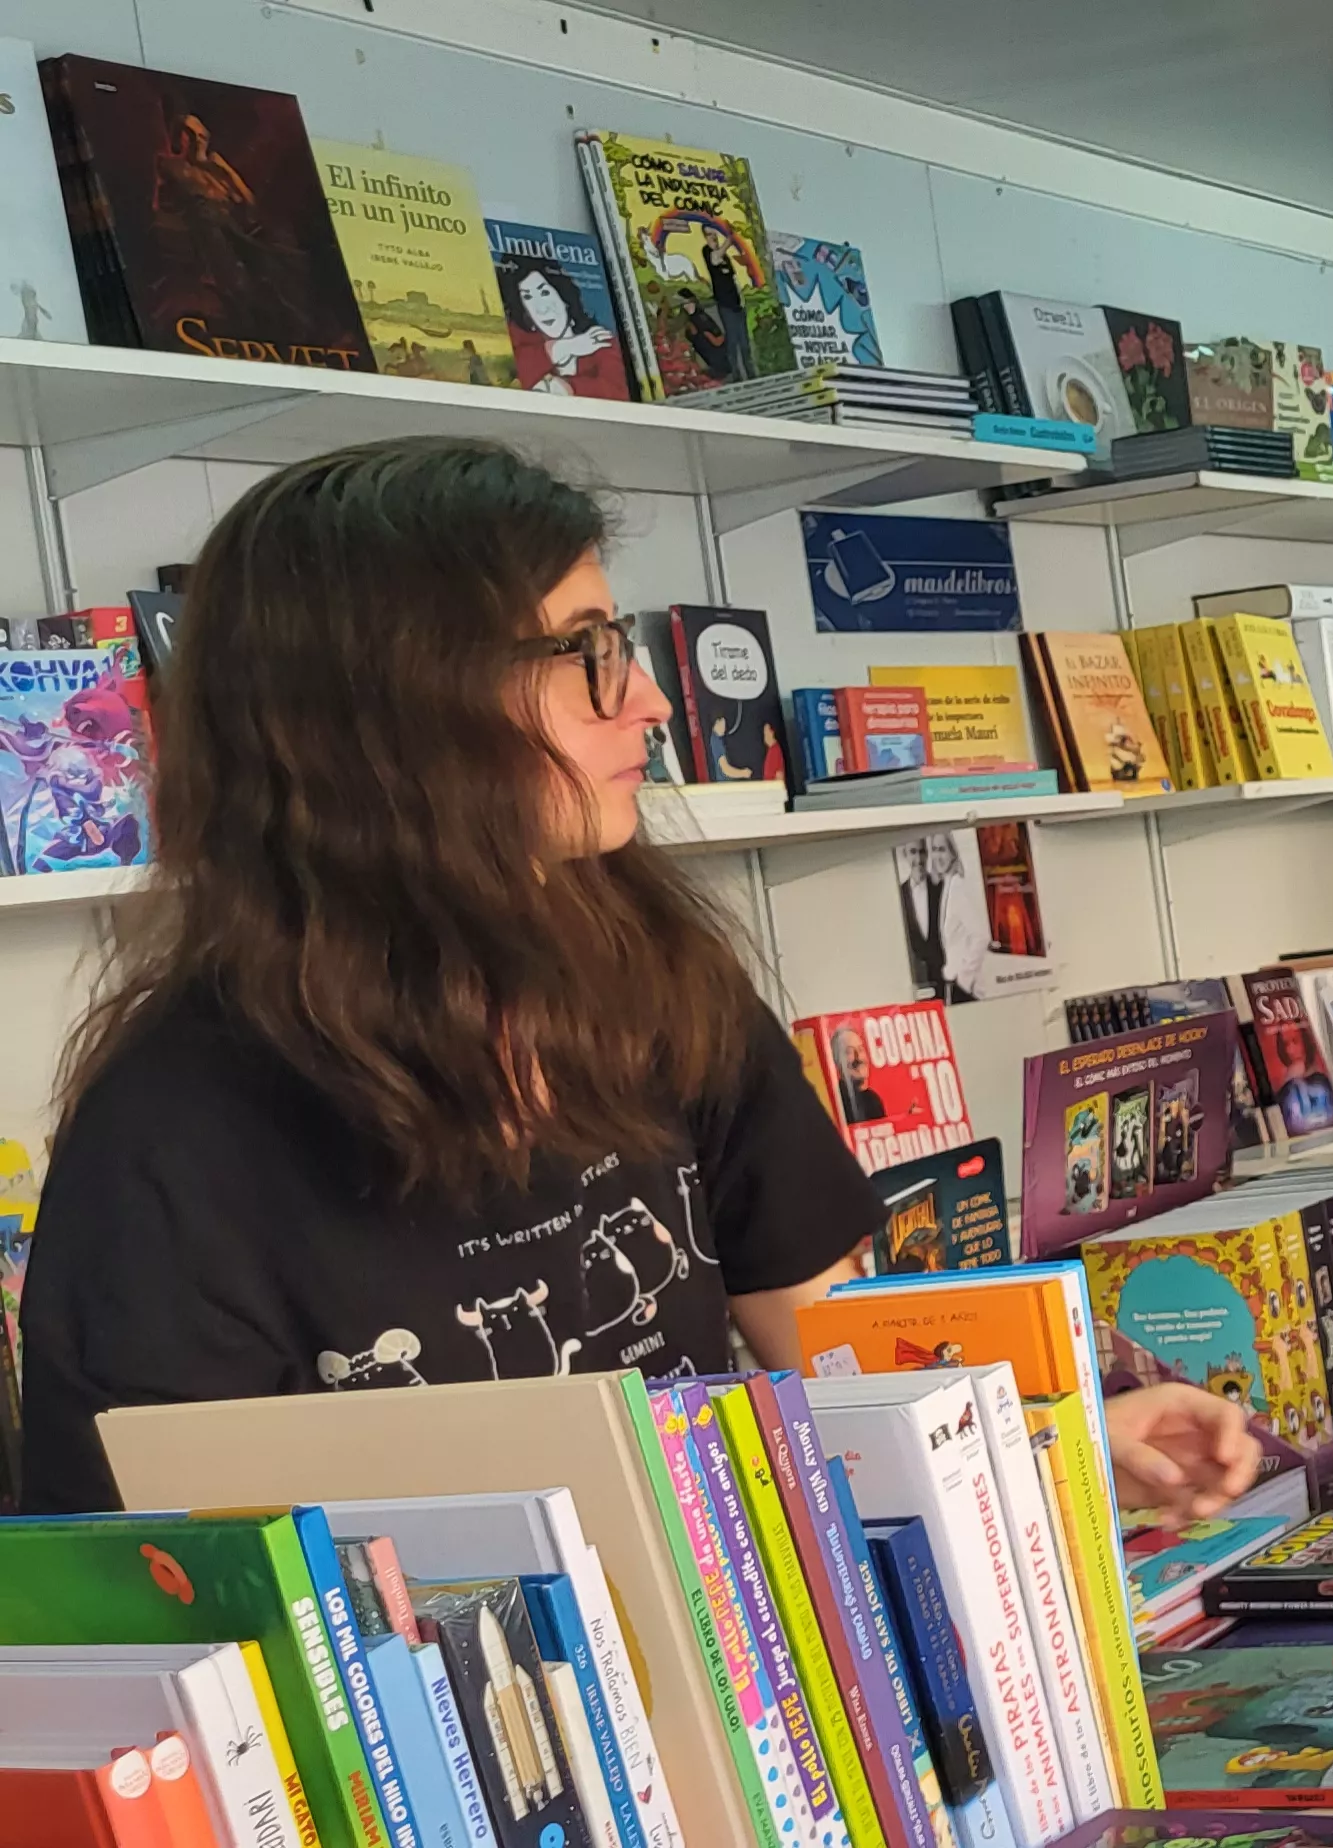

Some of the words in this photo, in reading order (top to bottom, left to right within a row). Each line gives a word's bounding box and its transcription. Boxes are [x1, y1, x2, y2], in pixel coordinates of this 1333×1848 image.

[325, 163, 356, 190] El
[361, 169, 453, 207] infinito
[640, 190, 670, 209] DEL
[657, 173, 732, 203] INDUSTRIA
[327, 197, 356, 218] en
[363, 203, 396, 224] un
[400, 203, 467, 236] junco
[1033, 306, 1084, 329] Orwell
[904, 569, 1013, 595] masdelibros
[1067, 674, 1132, 691] INFINITO
[862, 1008, 950, 1070] COCINA
[456, 1234, 492, 1260] IT'S
[494, 1208, 574, 1248] WRITTEN
[617, 1330, 667, 1366] GEMINI
[672, 1448, 699, 1507] fiesta
[706, 1440, 733, 1493] amigos
[776, 1442, 798, 1492] QUIJOTE
[723, 1490, 741, 1520] sus
[807, 1467, 829, 1514] WIND
[1074, 1438, 1106, 1545] prehistóricos
[690, 1505, 708, 1543] una
[734, 1518, 750, 1550] con
[698, 1542, 716, 1568] da
[972, 1471, 1024, 1642] SUPERPODERES
[324, 1586, 349, 1627] LOS
[690, 1587, 703, 1609] EL
[703, 1566, 730, 1623] PEPE
[740, 1550, 772, 1623] escondite
[858, 1558, 884, 1615] JORGE
[1097, 1549, 1119, 1619] animales
[697, 1606, 716, 1649] LIBRO
[759, 1622, 780, 1645] al
[874, 1617, 893, 1650] SAN
[1024, 1520, 1082, 1715] ASTRONAUTAS
[1111, 1616, 1127, 1661] otros
[291, 1596, 350, 1733] SENSIBLES
[335, 1625, 359, 1662] MIL
[574, 1643, 586, 1670] 326
[708, 1648, 720, 1667] DE
[723, 1617, 748, 1671] pollo
[884, 1649, 900, 1675] DE
[713, 1665, 727, 1690] LOS
[734, 1668, 752, 1695] El
[989, 1640, 1030, 1753] PIRATAS
[347, 1660, 385, 1747] COLORES
[722, 1689, 741, 1735] CULOS
[780, 1689, 809, 1741] PEPE
[891, 1676, 914, 1726] LIBRO
[586, 1683, 607, 1732] IRENE
[600, 1733, 625, 1793] VALLEJO
[1020, 1672, 1059, 1789] ANIMALES
[371, 1744, 395, 1782] DEL
[430, 1675, 462, 1750] Nieves
[452, 1752, 488, 1840] Herrero
[798, 1737, 827, 1783] pollo
[284, 1771, 303, 1799] MI
[381, 1779, 408, 1824] HILO
[809, 1780, 830, 1809] El
[292, 1797, 317, 1848] GATO
[347, 1769, 382, 1848] MIRIAM
